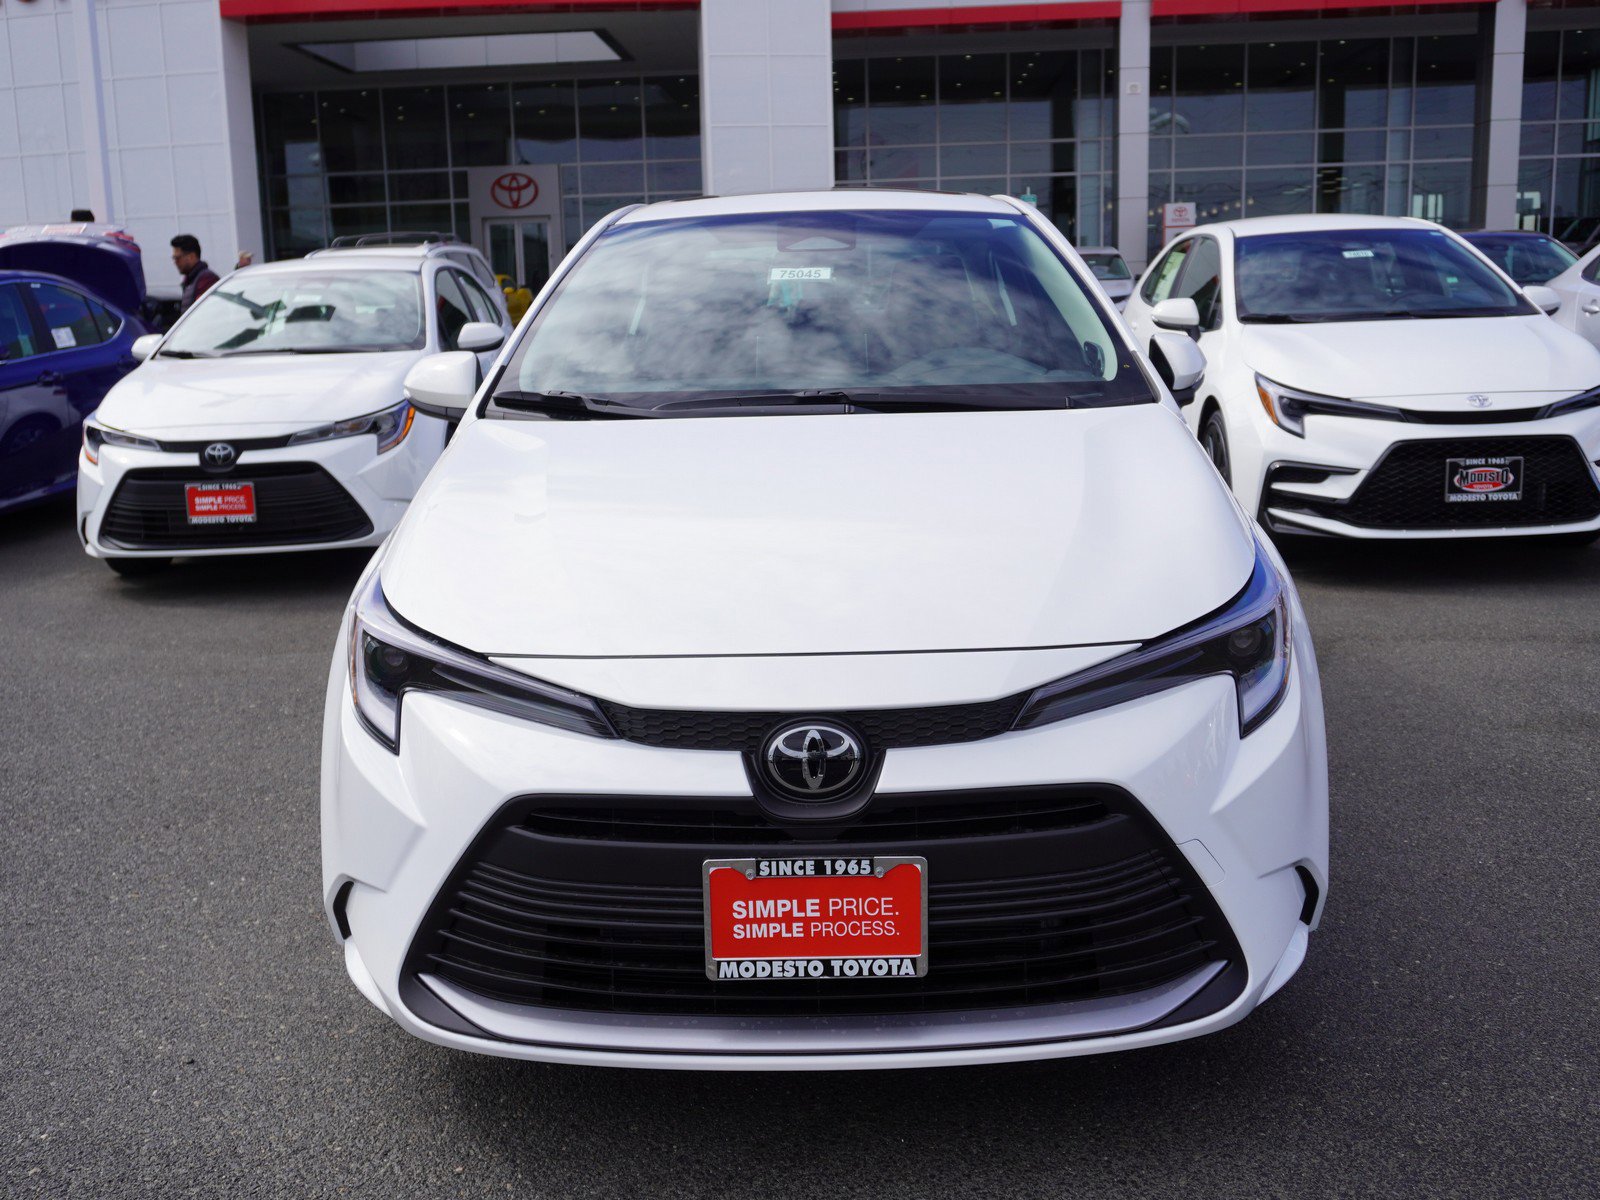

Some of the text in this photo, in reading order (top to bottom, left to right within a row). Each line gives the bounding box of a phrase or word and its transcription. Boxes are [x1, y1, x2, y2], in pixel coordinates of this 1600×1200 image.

[779, 269, 822, 279] 75045
[1465, 458, 1486, 466] SINCE
[1459, 467, 1509, 486] MODESTO
[194, 495, 223, 505] SIMPLE
[1449, 494, 1487, 502] MODESTO
[191, 515, 253, 525] MODESTO TOYOTA
[759, 859, 871, 876] SINCE 1965
[732, 897, 900, 919] SIMPLE PRICE.
[732, 920, 900, 939] SIMPLE PROCESS.
[718, 958, 916, 979] MODESTO TOYOTA
